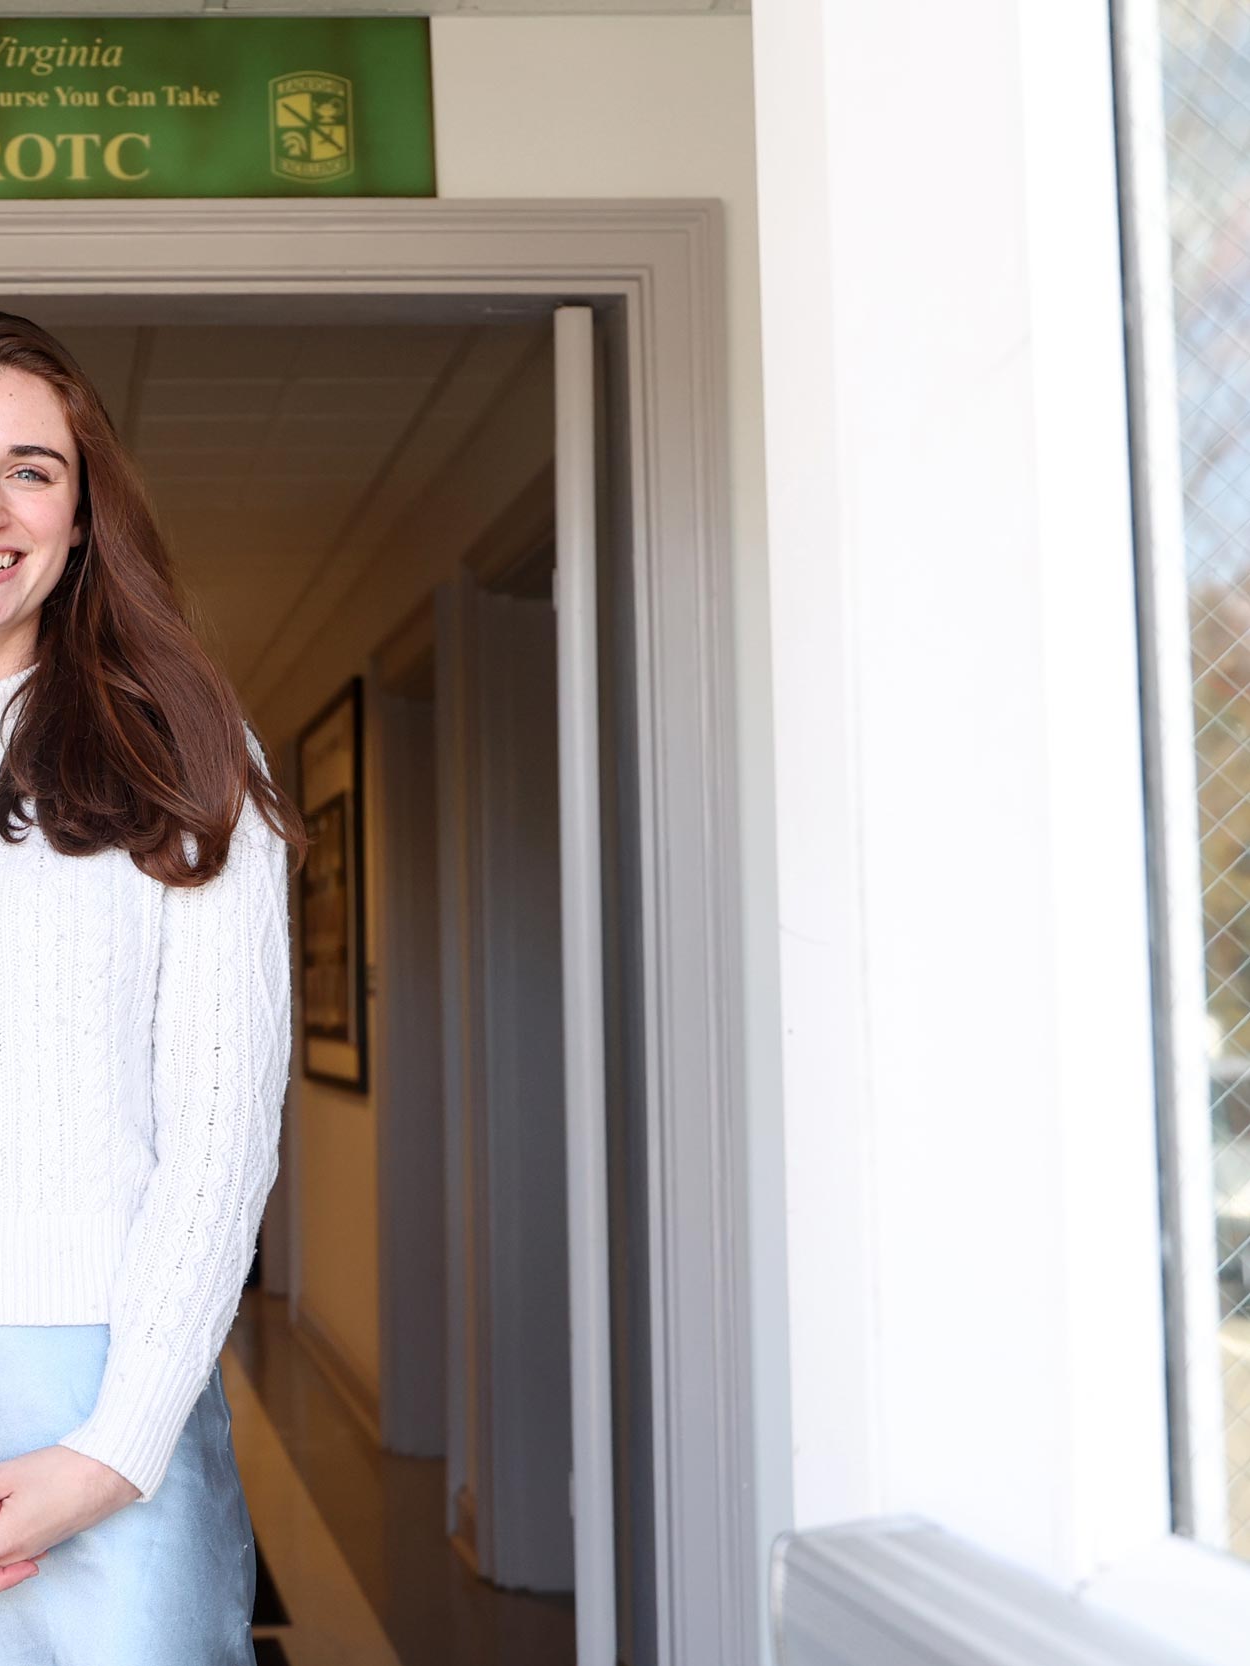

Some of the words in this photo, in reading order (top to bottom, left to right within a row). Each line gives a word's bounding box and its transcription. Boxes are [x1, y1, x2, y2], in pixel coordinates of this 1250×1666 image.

[54, 86, 99, 107] You
[106, 85, 156, 107] Can
[161, 86, 220, 107] Take
